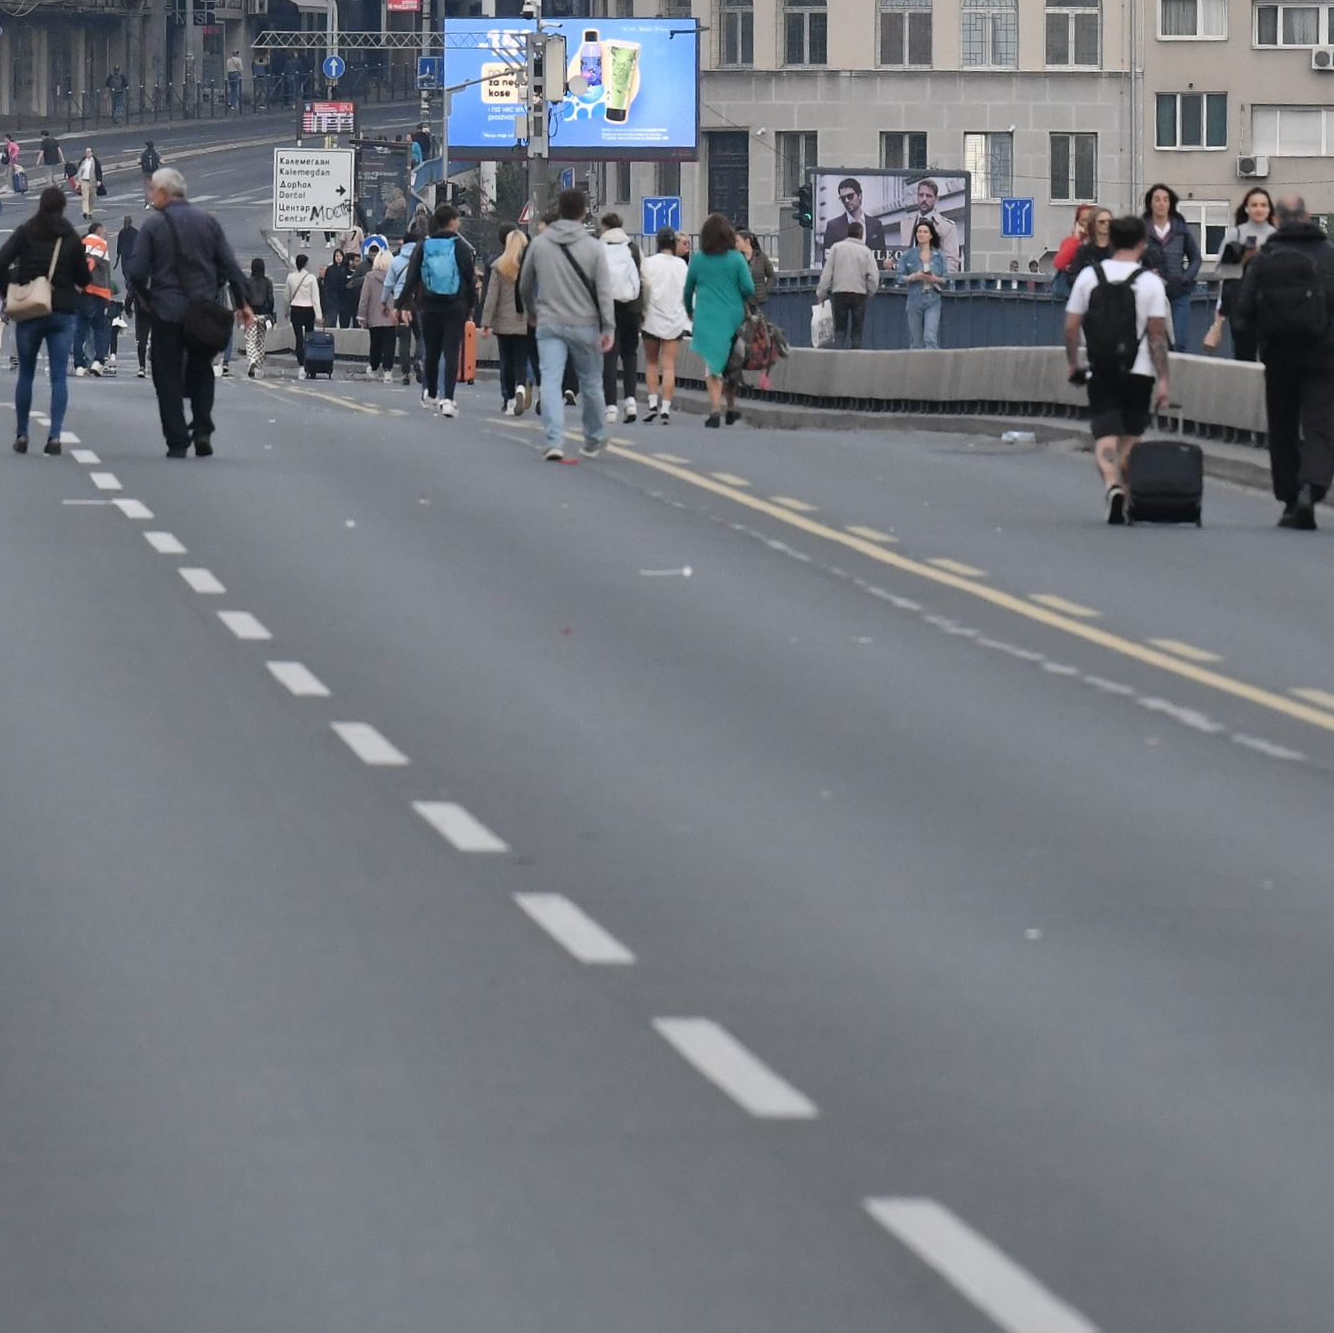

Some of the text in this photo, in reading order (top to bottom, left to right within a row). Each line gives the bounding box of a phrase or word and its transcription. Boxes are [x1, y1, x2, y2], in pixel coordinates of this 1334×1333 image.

[479, 29, 531, 57] -15
[488, 79, 500, 87] za
[488, 89, 511, 98] kose
[279, 157, 330, 166] Калемегдан
[279, 168, 331, 178] Kalemegdan
[280, 180, 312, 189] Дорћол
[278, 203, 310, 213] Центар
